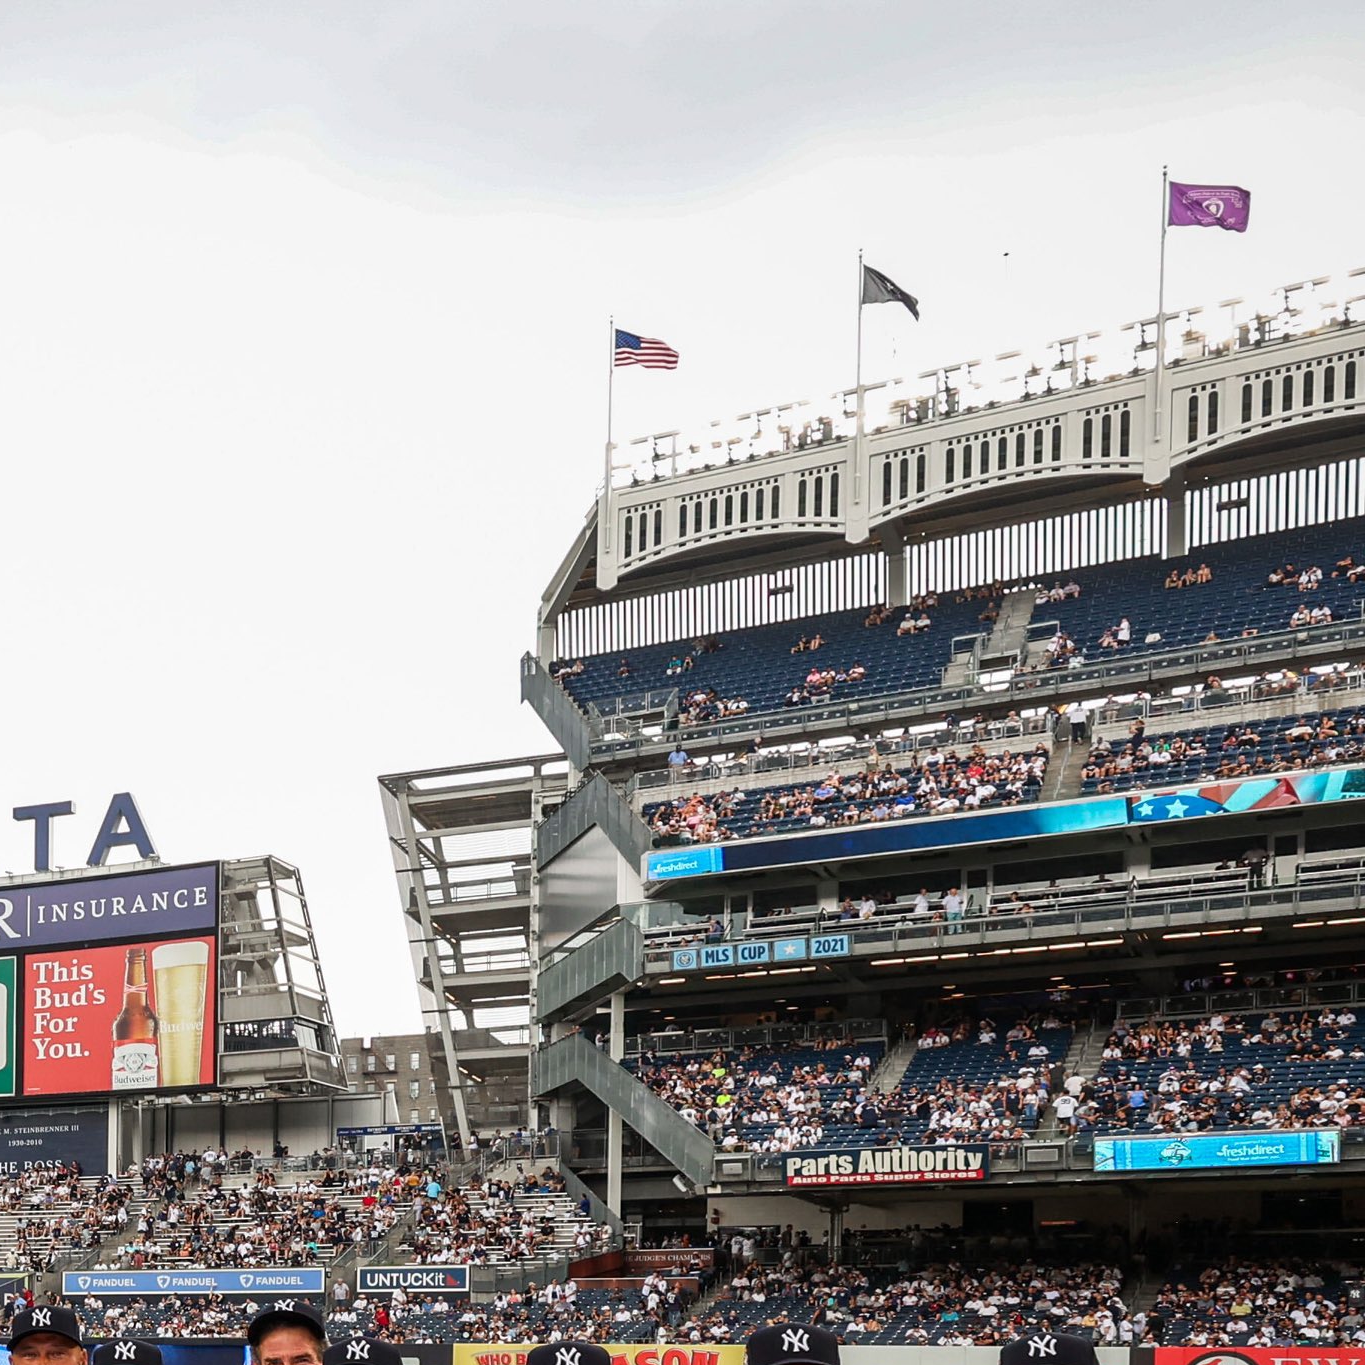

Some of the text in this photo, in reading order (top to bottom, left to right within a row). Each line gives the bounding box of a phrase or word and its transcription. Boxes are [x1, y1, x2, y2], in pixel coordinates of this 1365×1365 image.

[659, 861, 698, 873] freshdirect
[37, 886, 207, 924] INSURANCE
[705, 938, 844, 963] MLS CUP 2021
[33, 960, 93, 985] This
[34, 983, 106, 1010] Bud's
[33, 1013, 78, 1035] For
[33, 1038, 91, 1060] You.
[114, 1073, 157, 1086] Budweiser
[14, 1126, 69, 1136] STEINBRENNER
[8, 1138, 43, 1147] 1930-2010
[1222, 1143, 1285, 1157] freshdirect
[24, 1160, 62, 1172] BOSS
[786, 1148, 983, 1177] Parts Authority
[792, 1170, 978, 1184] Auto Parts Super Stores
[92, 1278, 136, 1287] FANDUEL
[172, 1277, 217, 1287] FANDUEL
[255, 1276, 303, 1286] FANDUEL
[366, 1273, 445, 1287] UNTUCKit
[30, 1306, 51, 1328] NY
[346, 1336, 370, 1360] NY
[1028, 1331, 1058, 1358] NY
